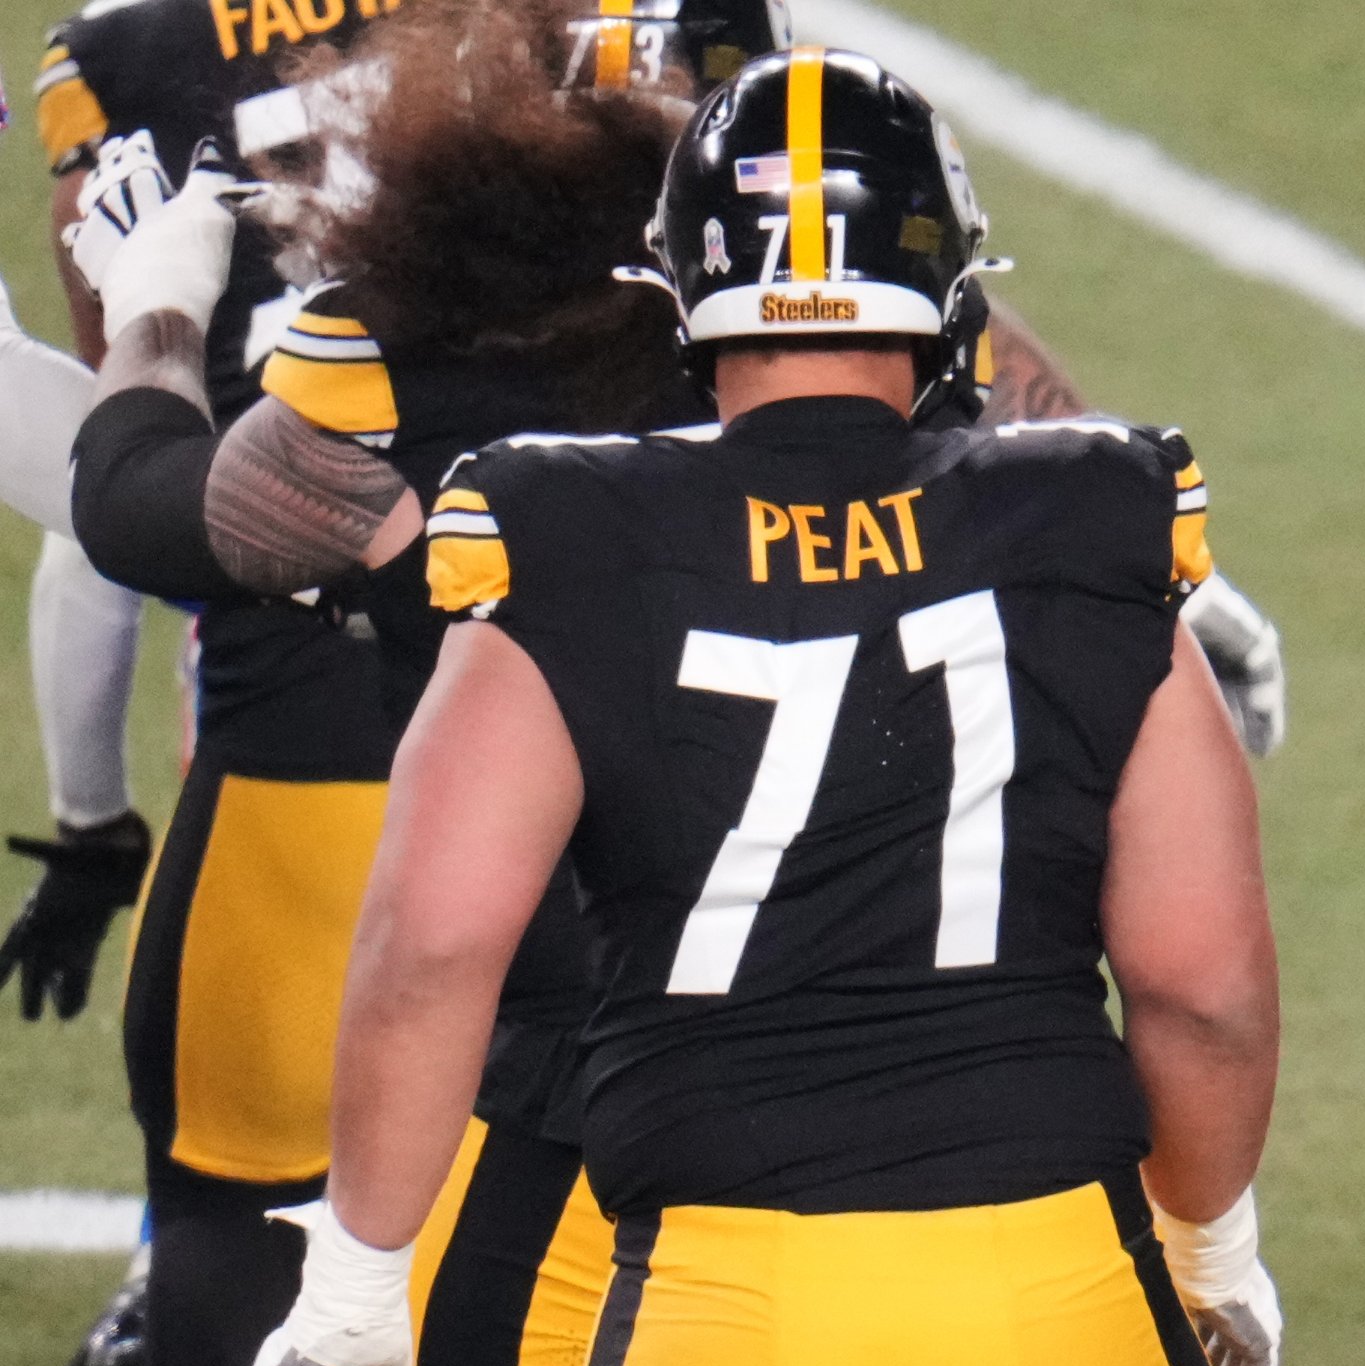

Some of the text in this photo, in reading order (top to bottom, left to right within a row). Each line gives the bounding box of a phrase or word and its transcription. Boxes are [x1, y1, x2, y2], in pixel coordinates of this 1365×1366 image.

[757, 214, 846, 285] 71
[760, 291, 859, 325] Steelers
[745, 487, 924, 583] PEAT
[665, 588, 1016, 995] 71
